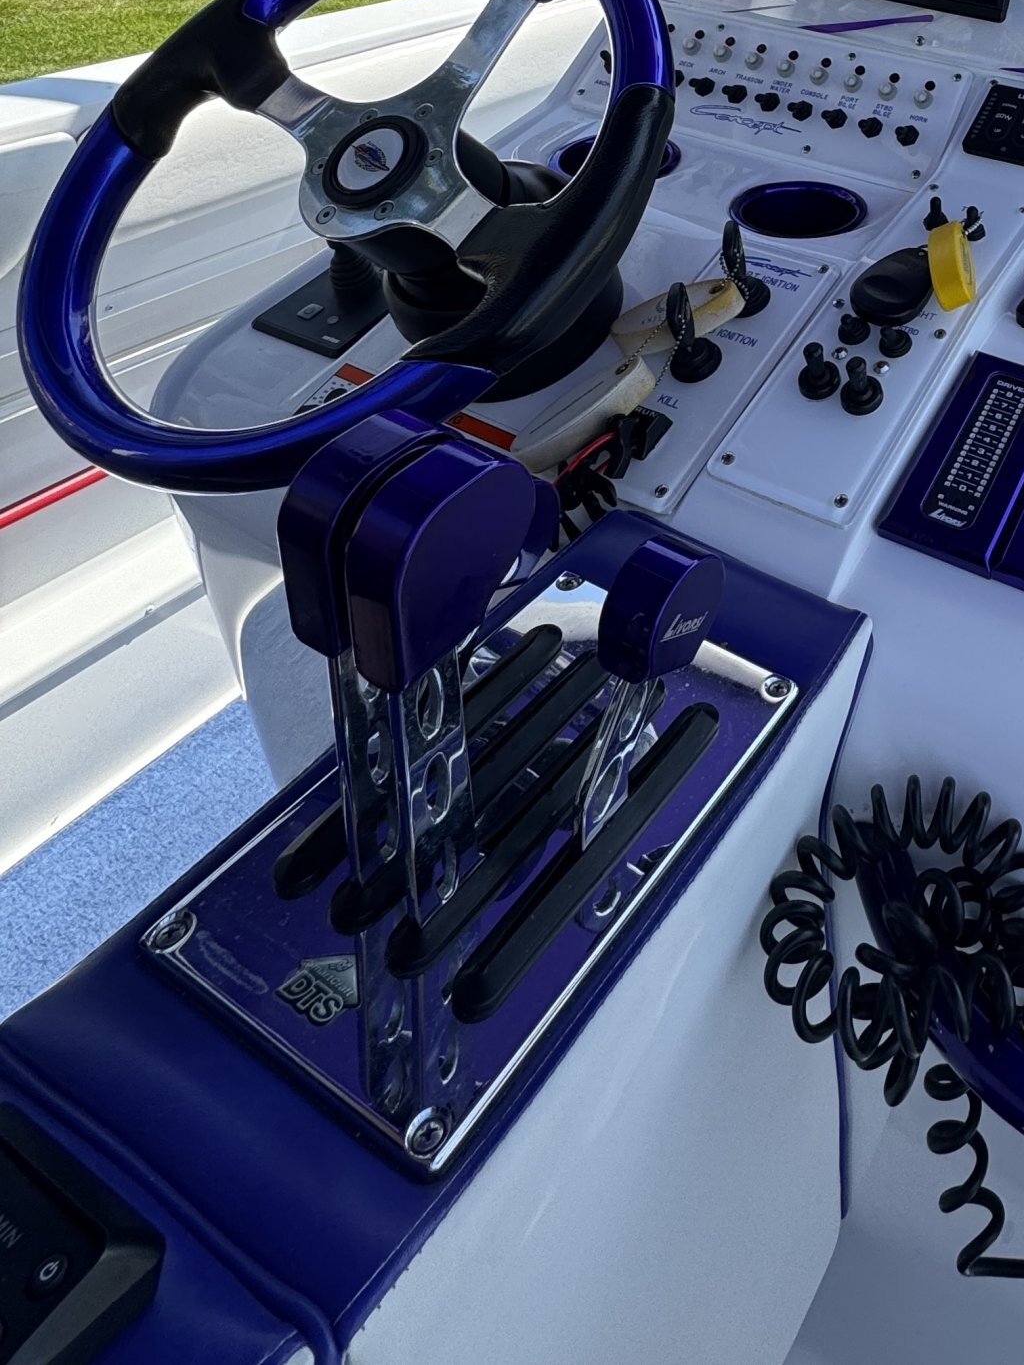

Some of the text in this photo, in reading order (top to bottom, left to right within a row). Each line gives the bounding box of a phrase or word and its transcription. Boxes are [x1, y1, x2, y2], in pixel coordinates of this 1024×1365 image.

[709, 67, 726, 75] ARCH
[736, 74, 764, 85] TRANSOM
[773, 80, 793, 88] UNDER
[770, 85, 791, 94] WATER
[800, 89, 829, 100] CONSOLE
[841, 95, 859, 104] PORT
[909, 114, 928, 123] HORN
[761, 275, 800, 292] IGNITION
[716, 328, 758, 347] IGNITION
[657, 395, 679, 409] KILL
[938, 501, 968, 515] WARNING
[279, 970, 344, 1022] DTS
